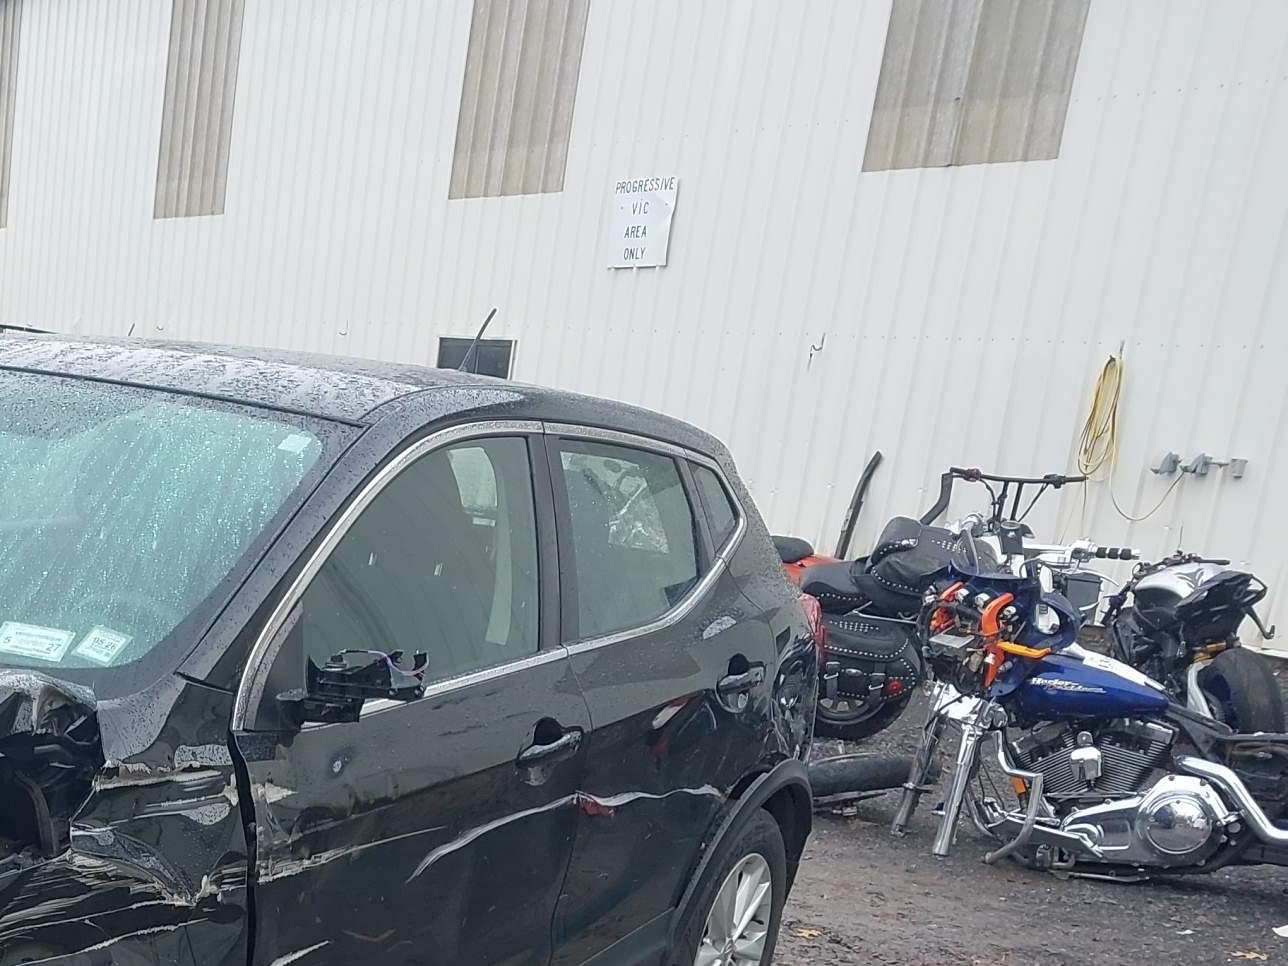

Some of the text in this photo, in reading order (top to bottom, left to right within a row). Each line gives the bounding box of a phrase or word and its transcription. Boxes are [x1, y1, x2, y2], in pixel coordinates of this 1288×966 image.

[615, 177, 675, 194] PROGRESSIVE
[632, 202, 650, 215] VIC
[624, 225, 648, 239] AREA
[623, 247, 646, 261] ONLY
